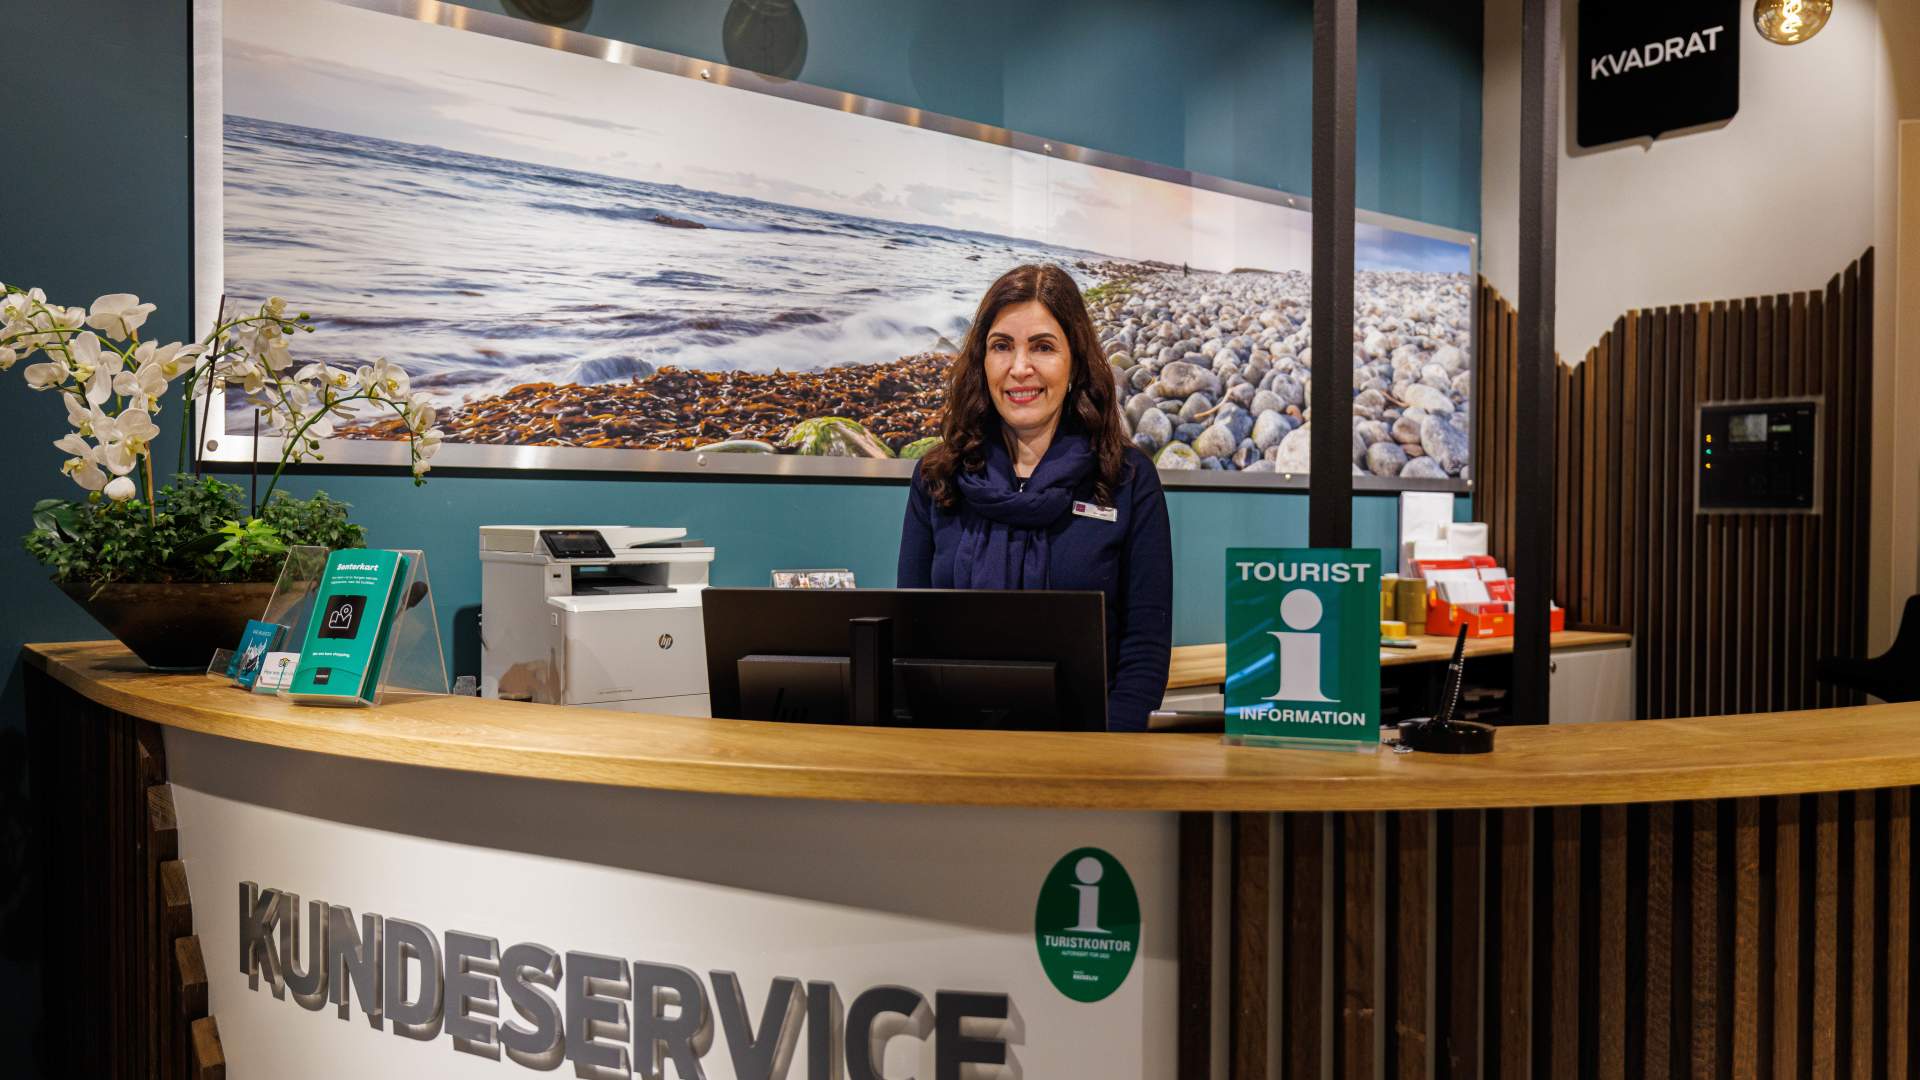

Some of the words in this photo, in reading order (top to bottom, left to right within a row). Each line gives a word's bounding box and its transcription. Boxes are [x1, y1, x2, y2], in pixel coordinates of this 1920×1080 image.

[1591, 26, 1724, 80] KVADRAT
[336, 563, 379, 572] Senterkart
[1236, 562, 1371, 583] TOURIST
[659, 633, 673, 650] hp
[1239, 708, 1366, 726] INFORMATION
[1044, 935, 1131, 952] TURISTKONTOR
[239, 881, 1016, 1080] KUNDESERVICE
